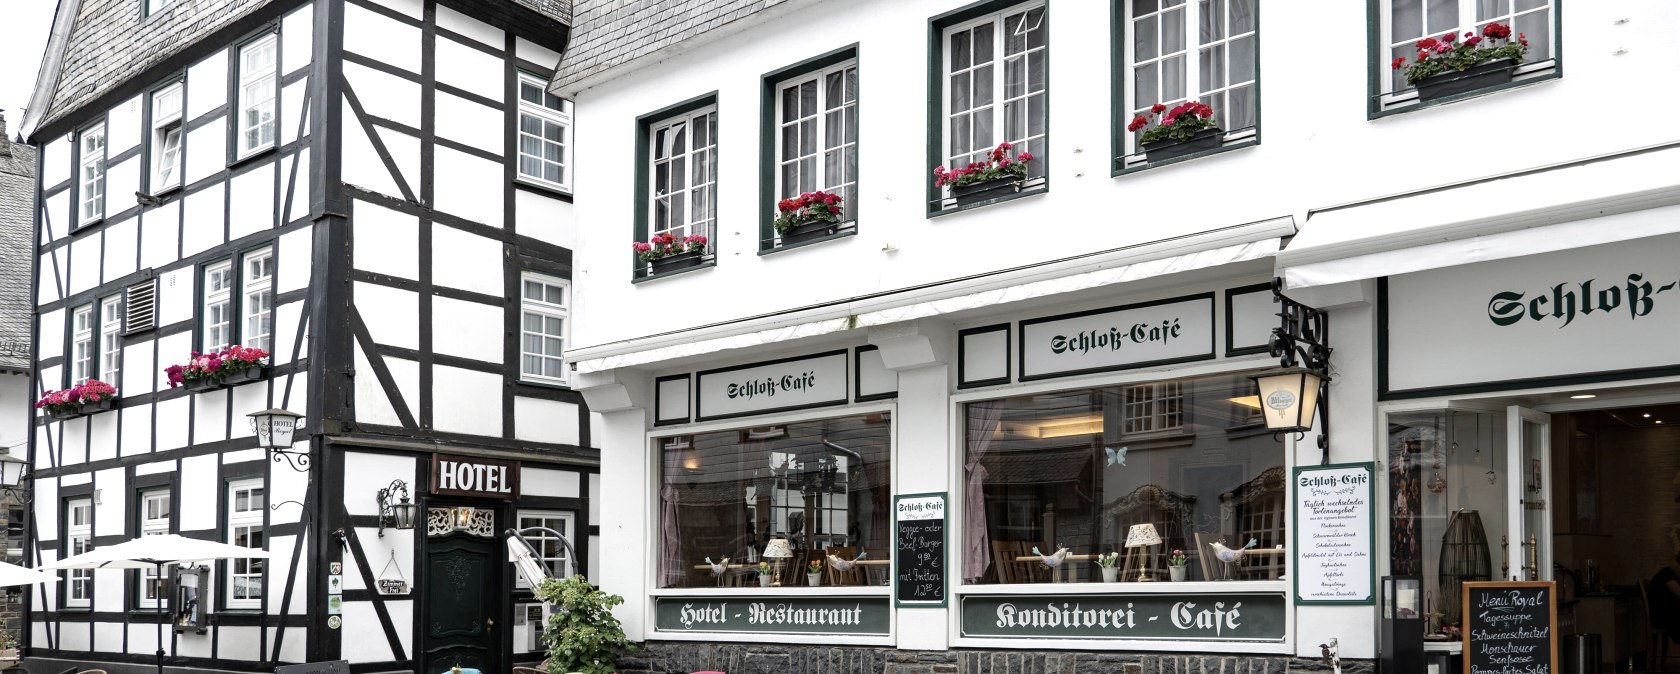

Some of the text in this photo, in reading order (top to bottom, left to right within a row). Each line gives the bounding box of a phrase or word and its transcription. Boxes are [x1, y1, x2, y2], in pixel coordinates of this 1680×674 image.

[1488, 272, 1680, 329] Schloß-
[1051, 318, 1181, 356] Schloß-Café
[727, 371, 815, 400] Schloß-Café
[274, 420, 293, 428] HOTEL
[439, 460, 512, 493] HOTEL
[1300, 474, 1367, 488] Schloß-Café
[899, 501, 943, 512] Schloß-Café
[1303, 498, 1364, 509] Täglich wechselndes
[1313, 506, 1358, 515] Tortenangebot
[924, 521, 942, 532] oder
[900, 569, 912, 582] mit
[1507, 590, 1544, 611] Royal
[680, 602, 728, 629] Hotel
[748, 602, 862, 626] Restaurant
[996, 602, 1136, 629] Konditorei
[1170, 601, 1242, 637] Café
[1479, 611, 1533, 627] Tagessuppe
[1471, 626, 1549, 642] Schweineschnitzel
[1480, 641, 1539, 654] Monschauer
